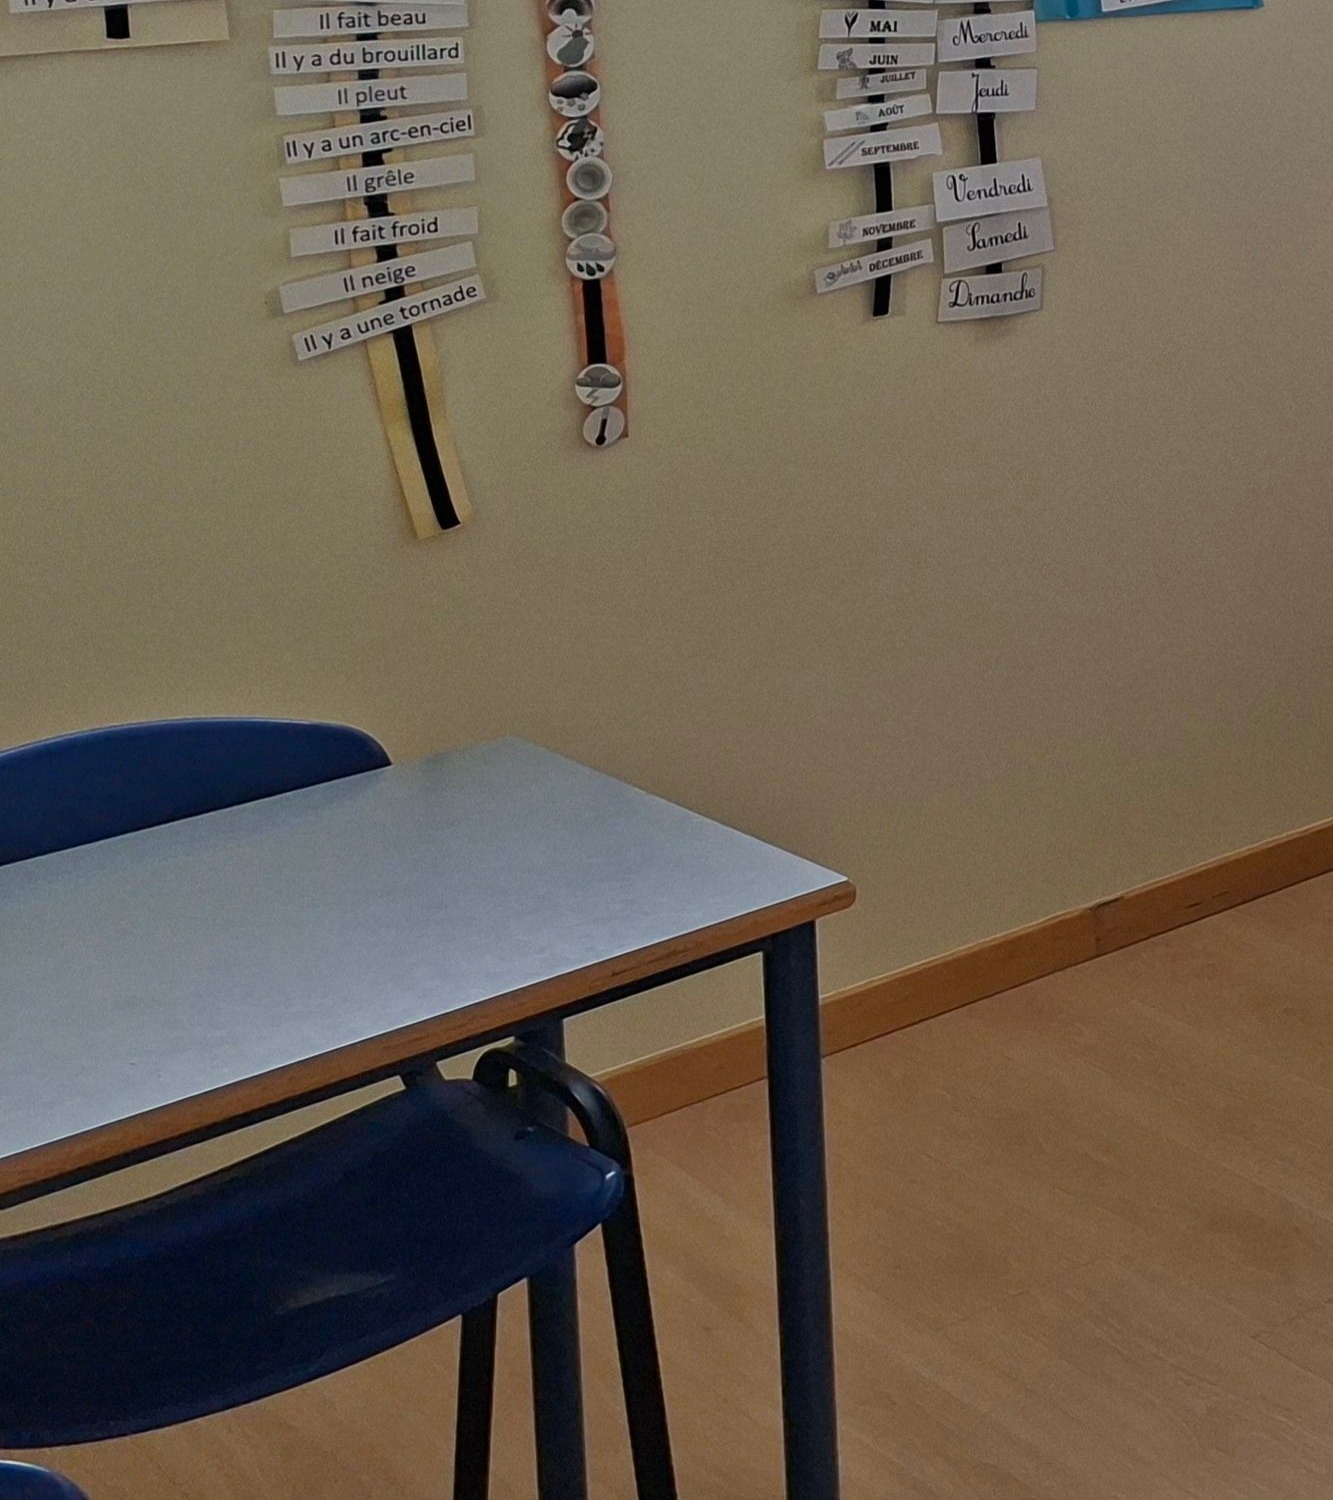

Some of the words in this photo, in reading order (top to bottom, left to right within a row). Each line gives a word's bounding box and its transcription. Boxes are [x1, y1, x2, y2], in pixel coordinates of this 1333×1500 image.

[320, 12, 330, 30] Il
[337, 12, 371, 29] fait
[377, 10, 426, 27] beau
[870, 20, 897, 32] MAI
[952, 20, 1029, 46] Mercredi
[275, 51, 286, 68] Il
[293, 56, 304, 73] y
[311, 54, 322, 66] a
[329, 48, 355, 65] du
[362, 42, 459, 64] brouillard
[869, 55, 898, 65] JUIN
[880, 71, 916, 83] JUILLET
[338, 88, 348, 105] Il
[356, 86, 408, 107] pleut
[971, 72, 1010, 113] Jeudi
[878, 104, 905, 117] AOÛT
[286, 140, 298, 158] Il
[303, 142, 314, 159] y
[321, 140, 332, 152] a
[338, 135, 364, 149] un
[370, 114, 473, 145] arc-en-ciel
[861, 141, 919, 156] SEPTEMBRE
[346, 175, 358, 192] Il
[364, 169, 415, 193] grêle
[946, 174, 1033, 202] Vendredi
[334, 228, 345, 245] Il
[352, 224, 386, 243] fait
[391, 216, 438, 238] froid
[862, 219, 916, 237] NOVEMBRE
[966, 222, 1028, 251] Samedi
[869, 249, 924, 273] DÉCEMBRE
[343, 275, 355, 293] Il
[361, 266, 416, 288] neige
[949, 272, 1036, 308] Dimanche
[304, 334, 317, 352] Il
[321, 333, 333, 349] y
[340, 328, 352, 340] a
[357, 313, 395, 334] une
[399, 285, 477, 320] tornade
